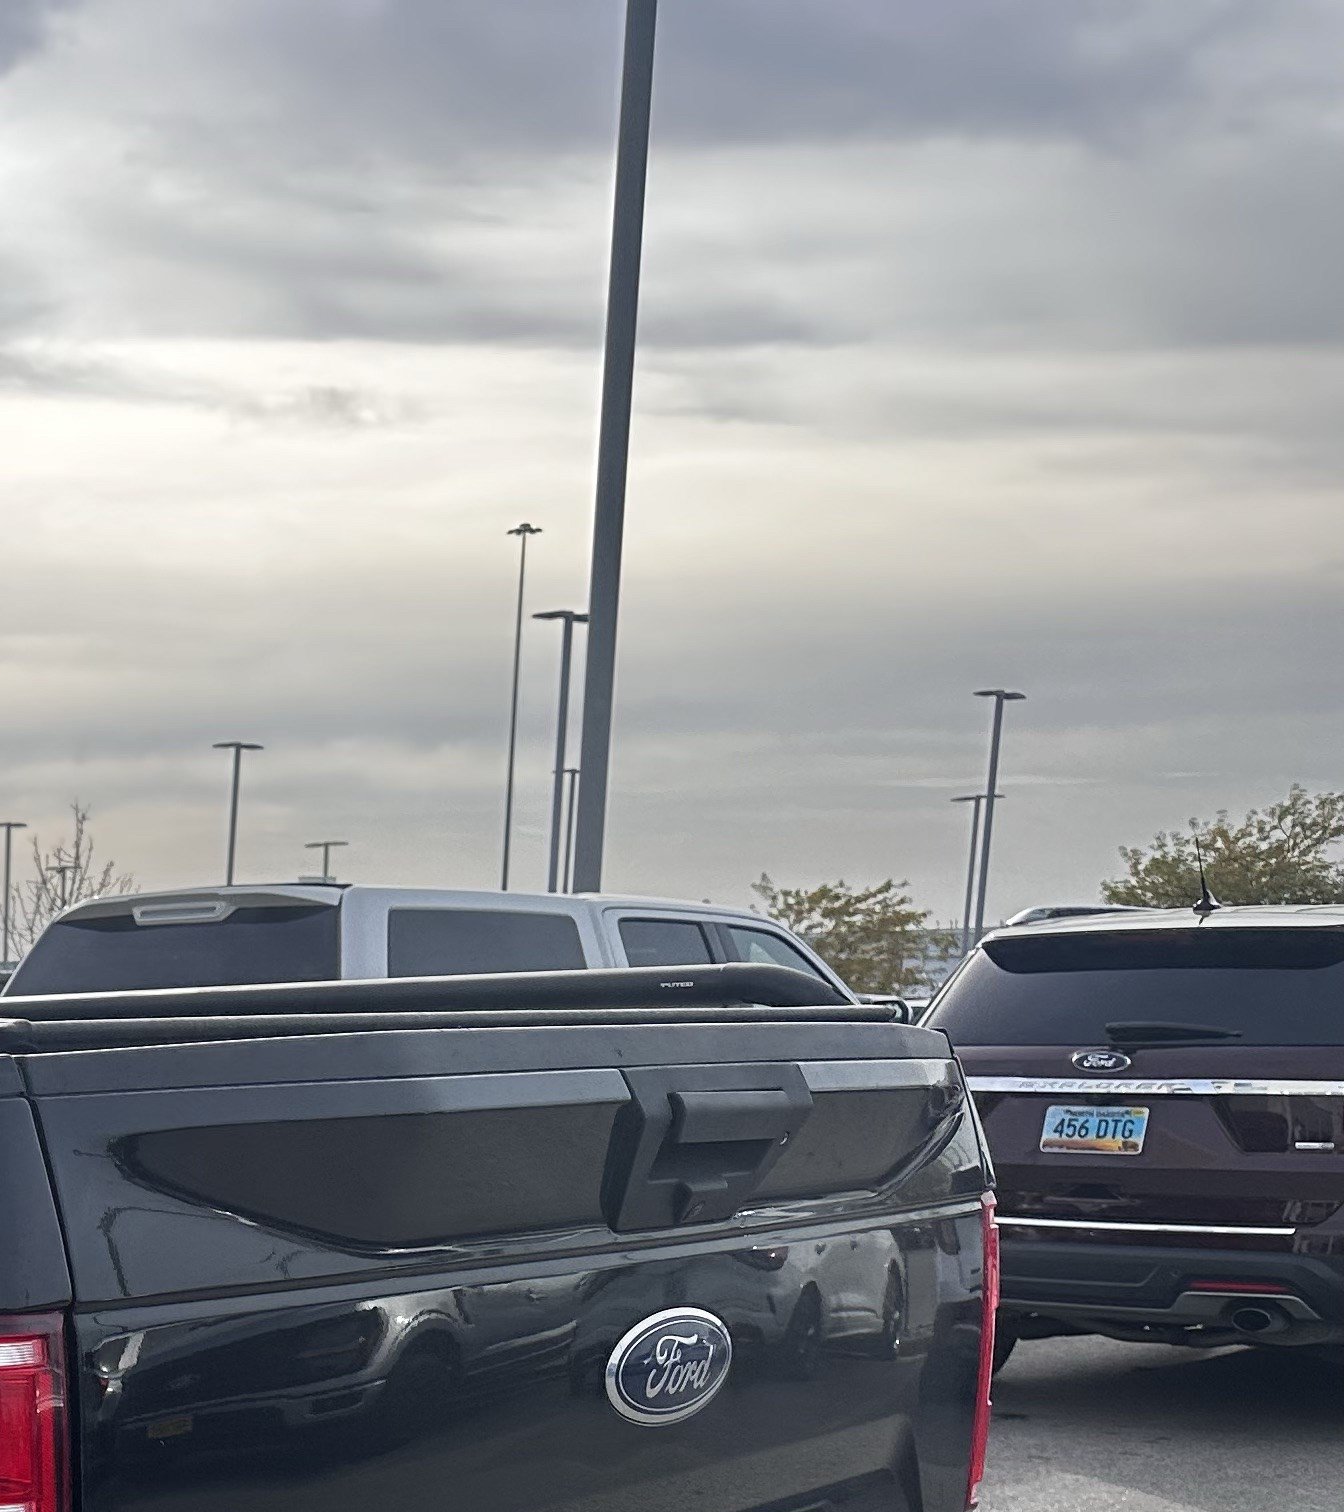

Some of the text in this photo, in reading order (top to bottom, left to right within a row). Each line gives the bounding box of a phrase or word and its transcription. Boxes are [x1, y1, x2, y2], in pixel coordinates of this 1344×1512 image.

[1053, 1117, 1136, 1140] 456 DTG
[643, 1333, 717, 1399] Ford
